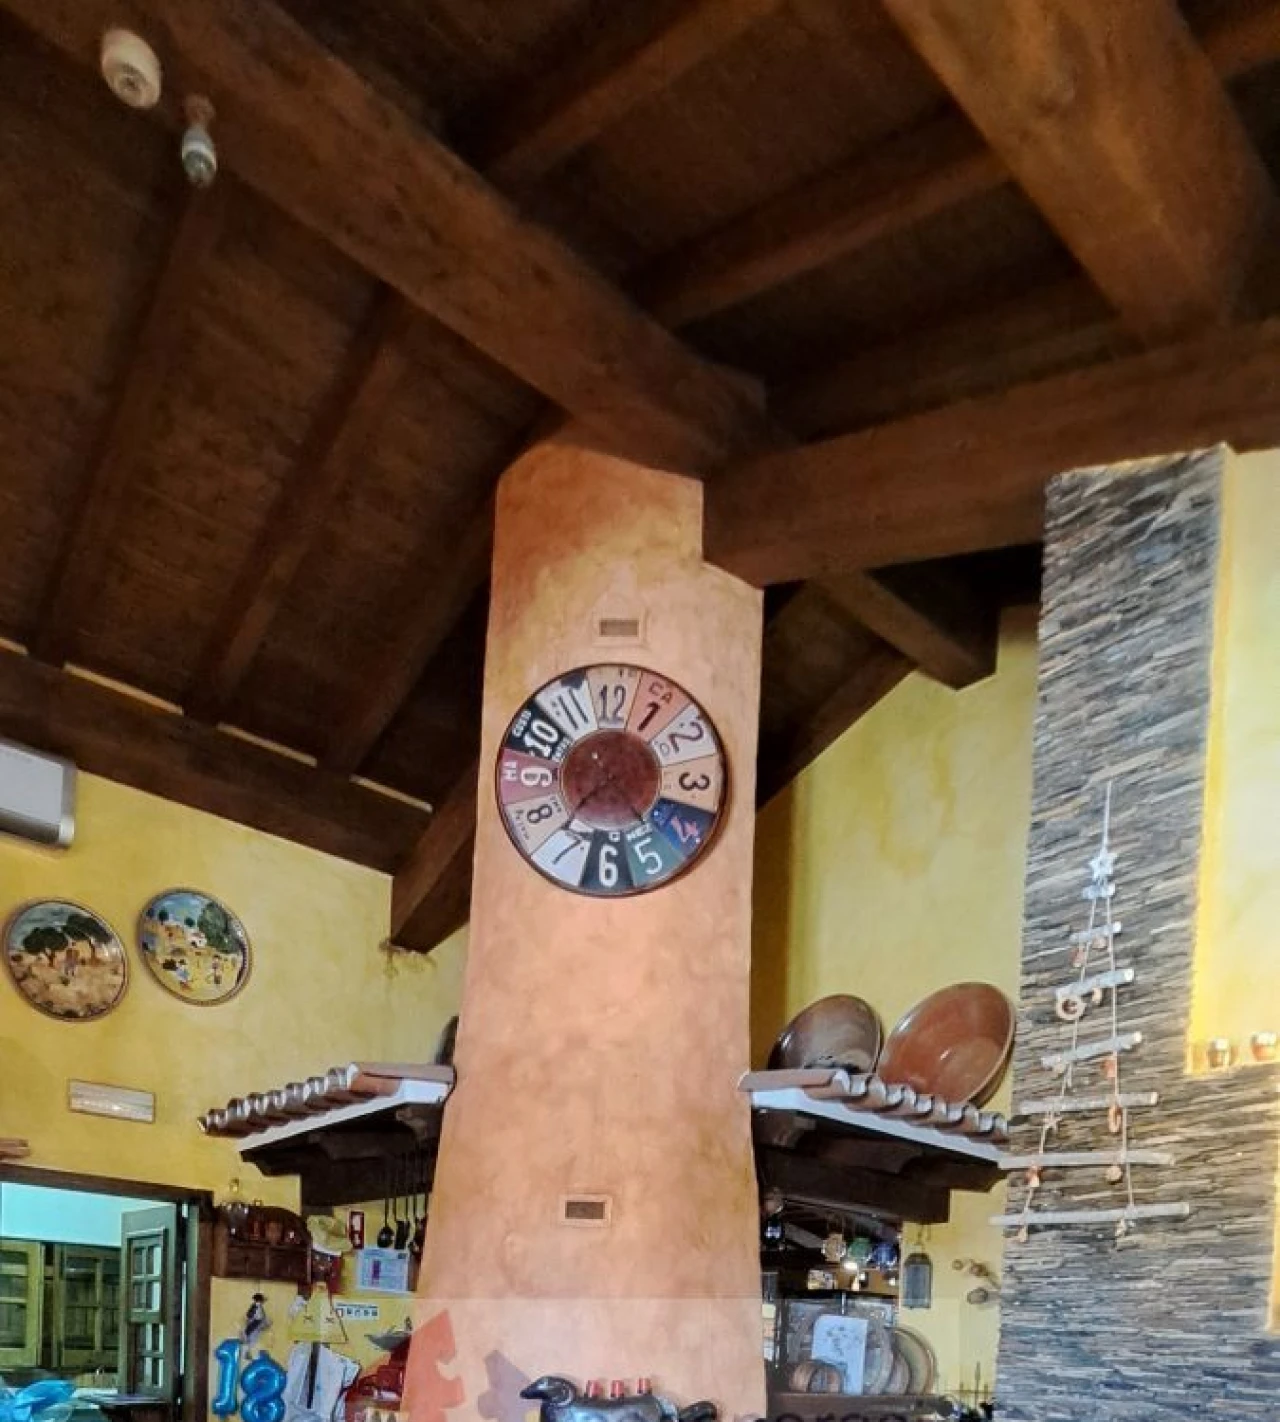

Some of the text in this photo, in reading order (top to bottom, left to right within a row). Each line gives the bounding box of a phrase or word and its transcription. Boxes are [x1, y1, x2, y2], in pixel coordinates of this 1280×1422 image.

[599, 684, 627, 726] 12
[649, 681, 674, 705] CA
[638, 702, 661, 732] 1
[523, 719, 560, 759] 10
[668, 721, 704, 754] 2
[520, 766, 553, 787] 9
[678, 771, 711, 791] 3
[526, 804, 553, 824] 8
[599, 844, 618, 888] 6
[634, 837, 663, 875] 5
